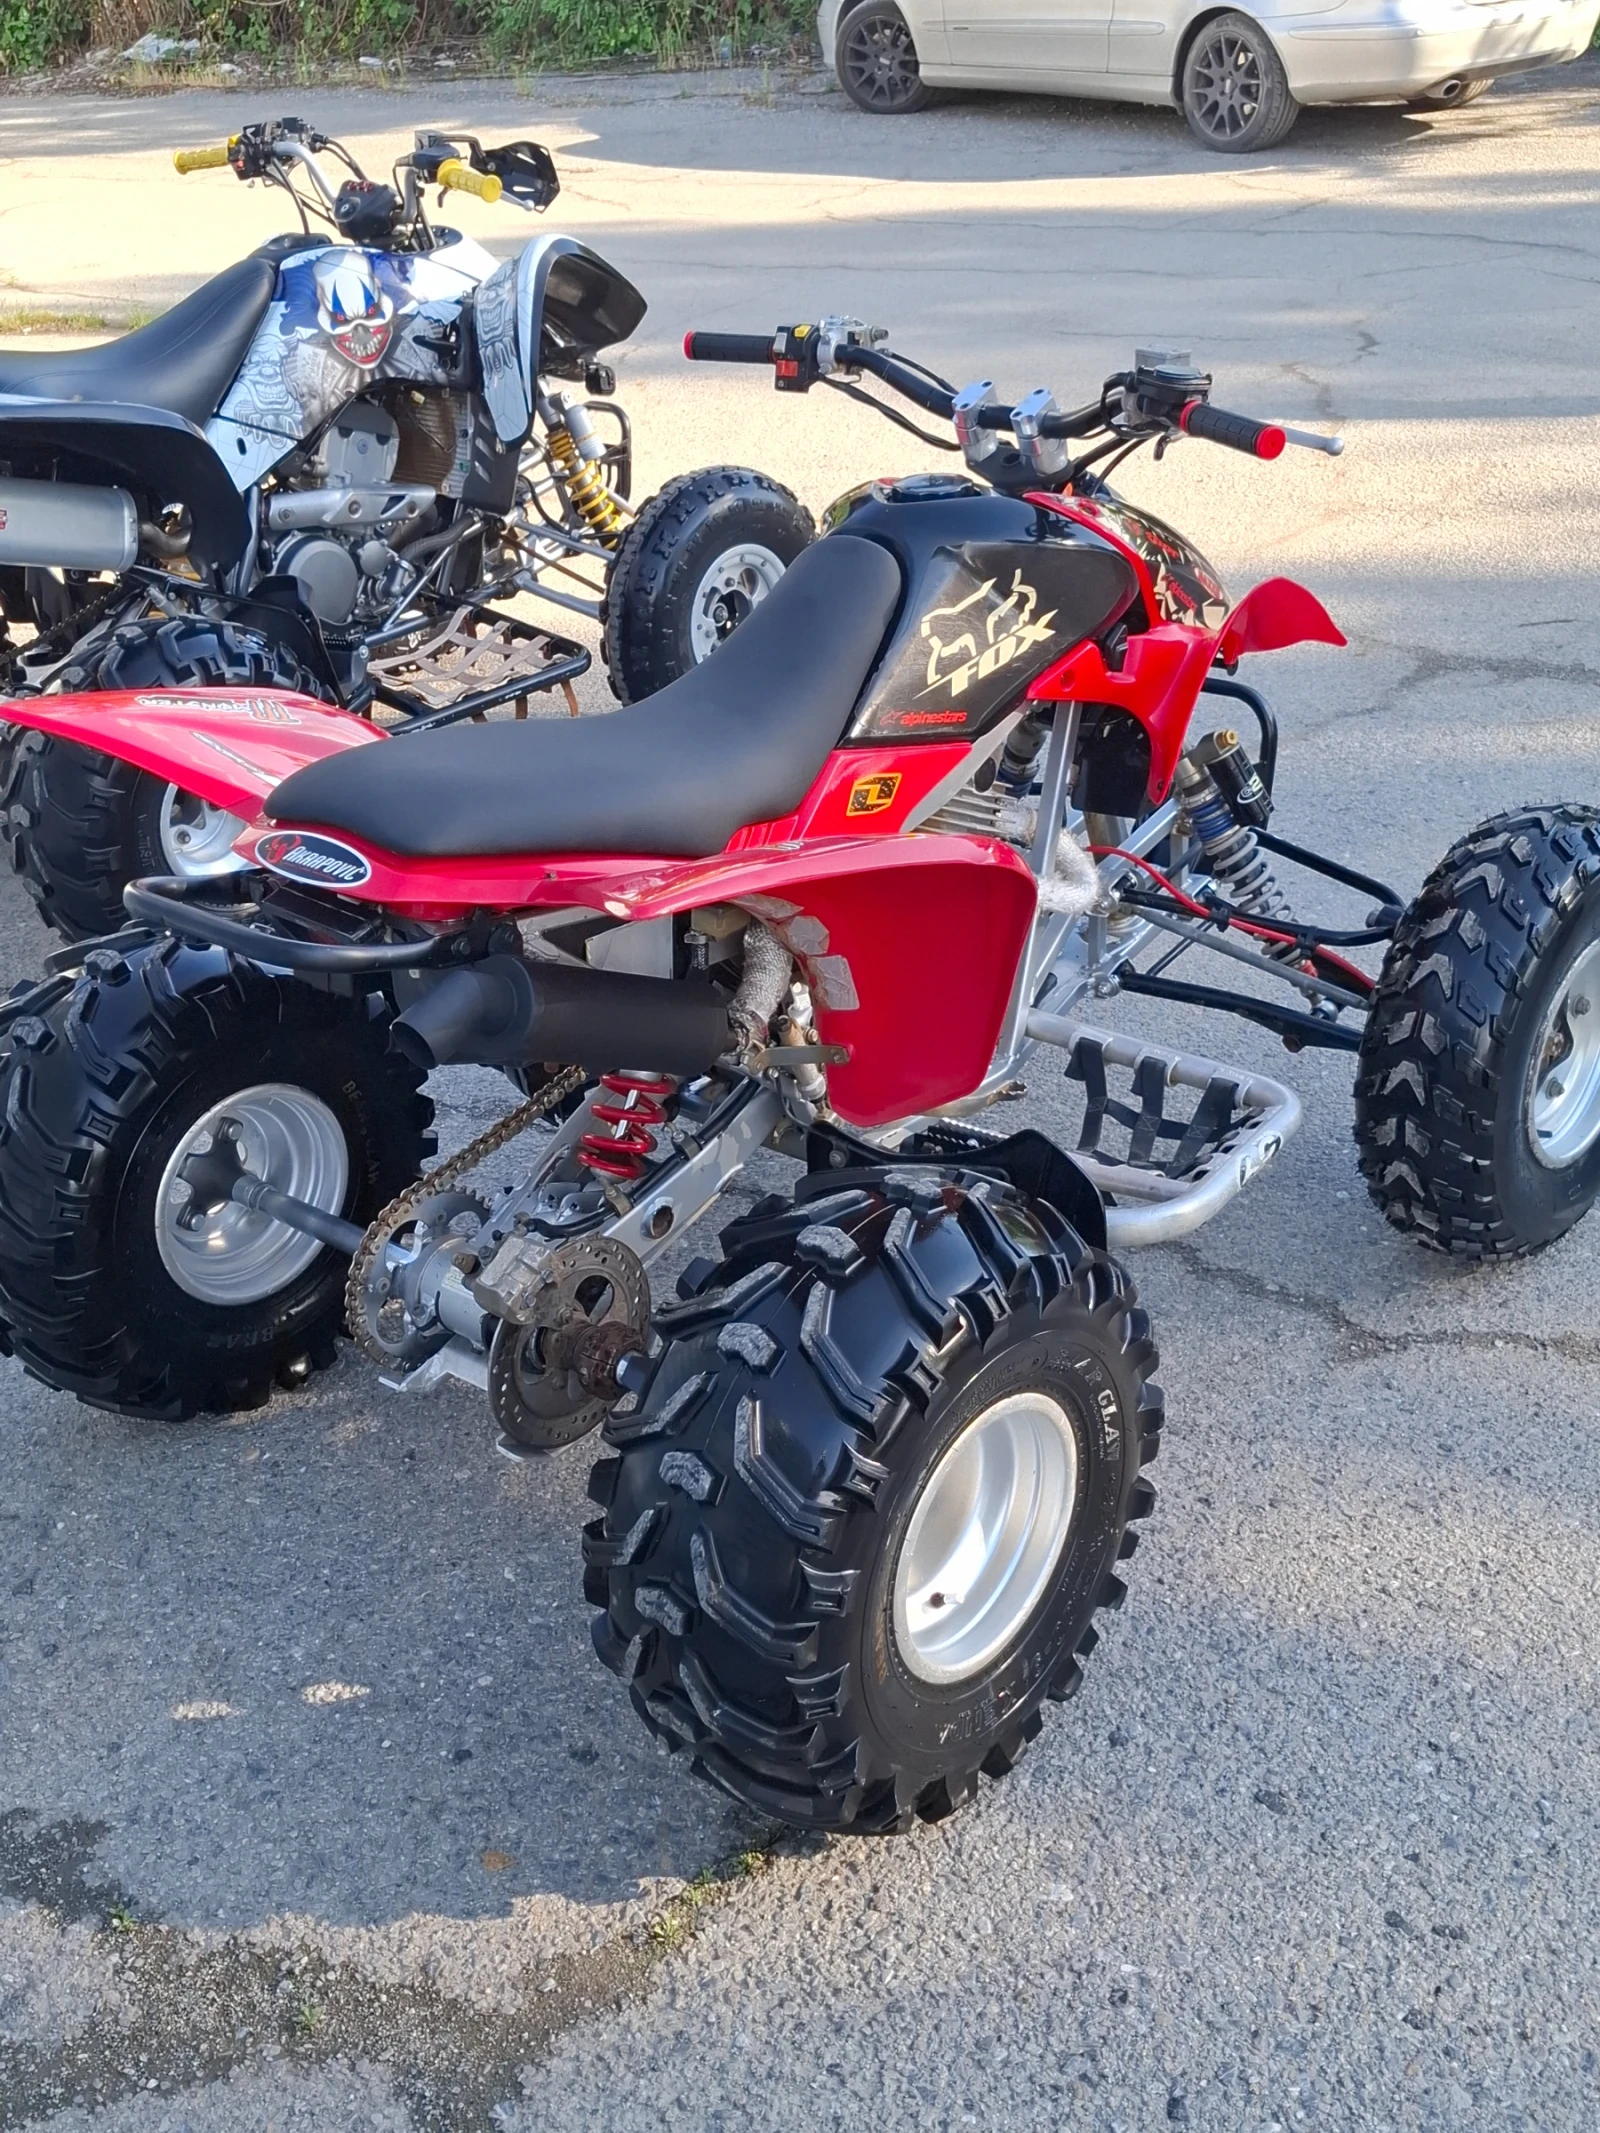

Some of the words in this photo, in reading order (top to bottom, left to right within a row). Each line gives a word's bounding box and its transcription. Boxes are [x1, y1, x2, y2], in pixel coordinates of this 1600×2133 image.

[912, 608, 1059, 699] FOX
[900, 710, 968, 727] alpinestars
[1097, 1388, 1121, 1461] CLAW
